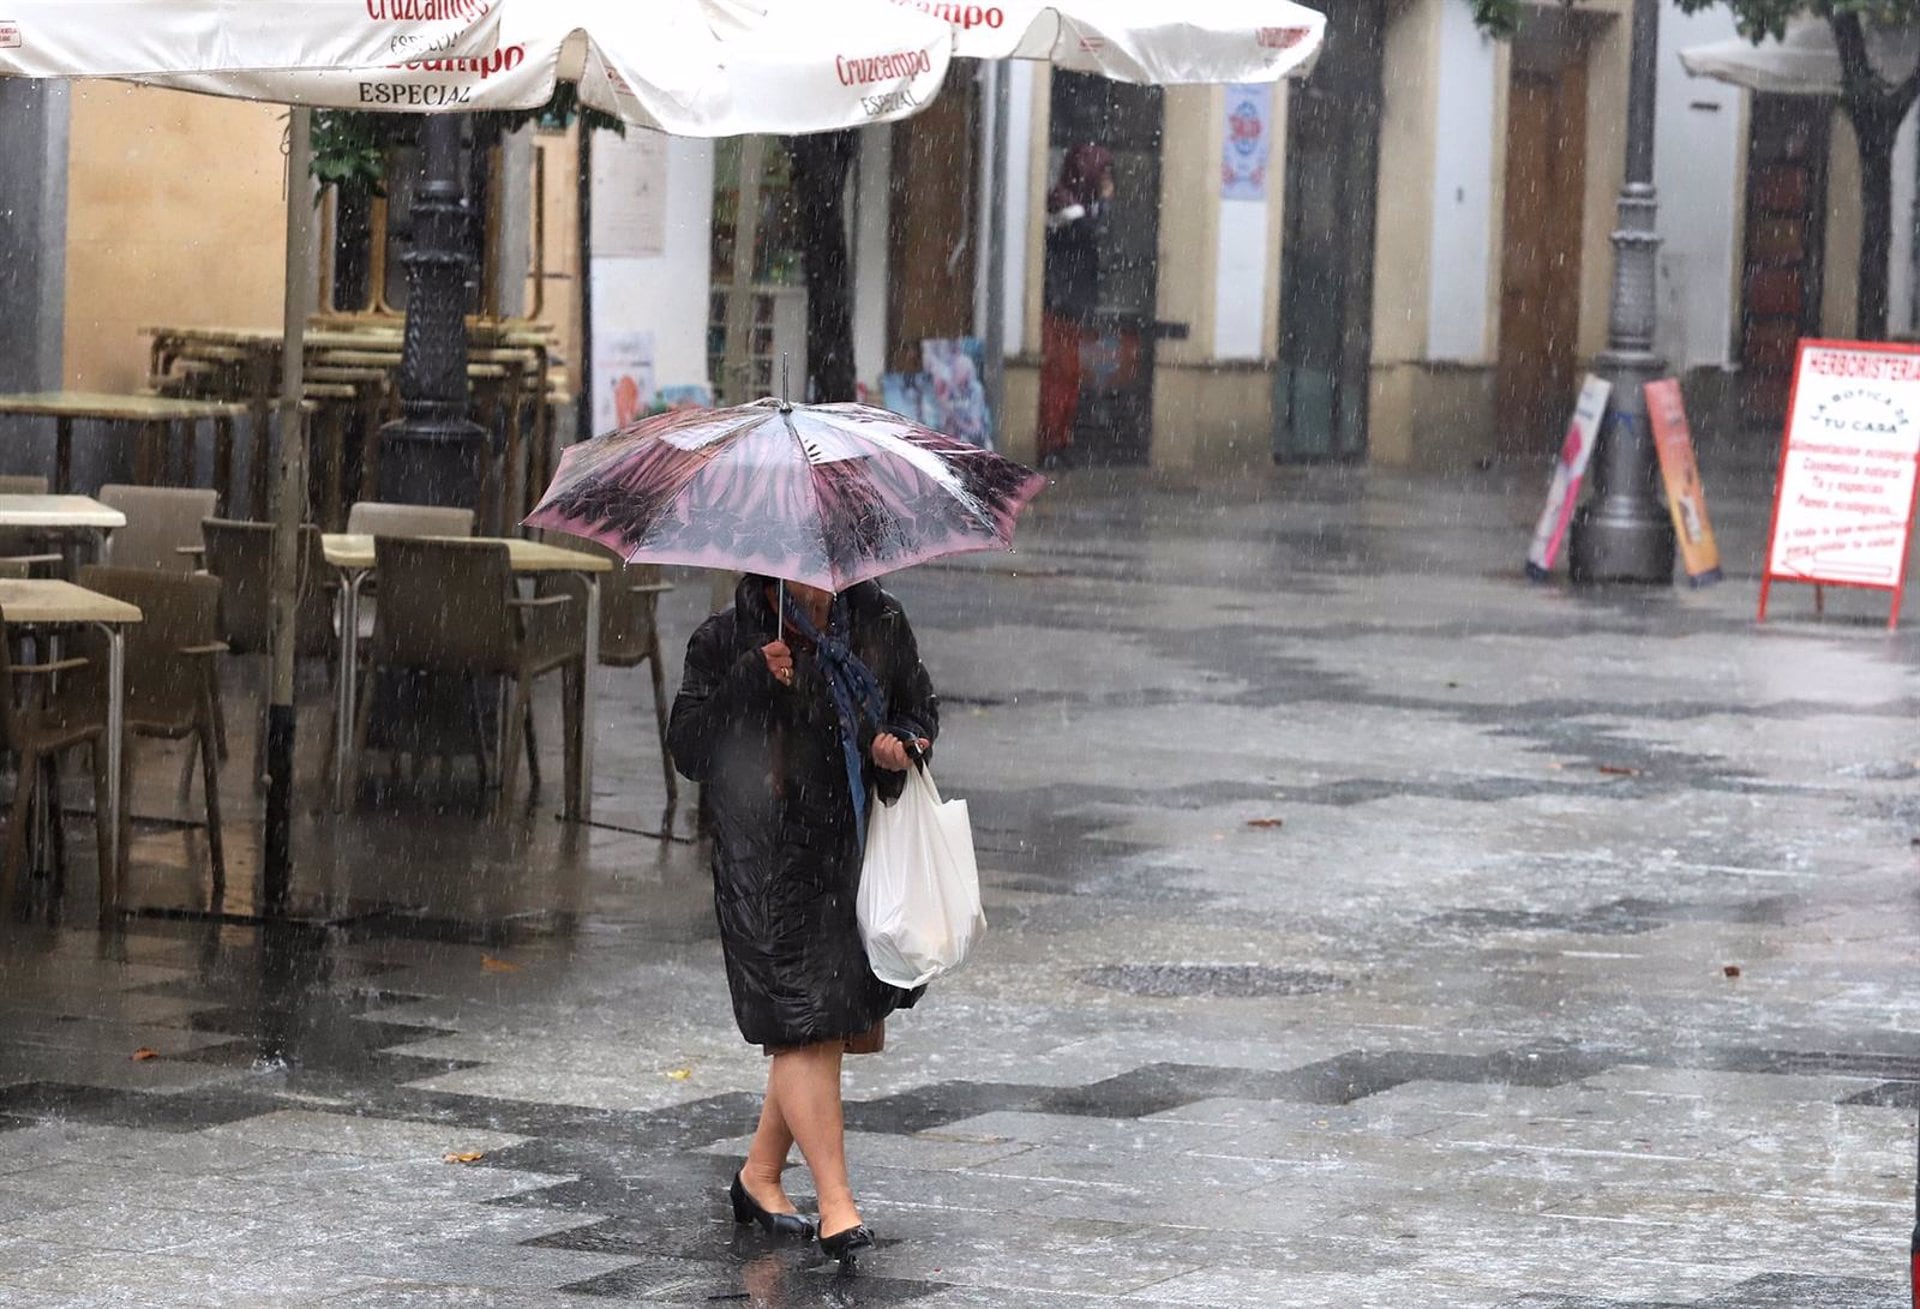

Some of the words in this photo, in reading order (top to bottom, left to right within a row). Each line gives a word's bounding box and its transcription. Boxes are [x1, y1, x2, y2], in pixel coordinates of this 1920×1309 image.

[836, 49, 931, 86] Cruzcampo
[359, 82, 471, 106] ESPECIAL
[1851, 421, 1898, 434] CASA
